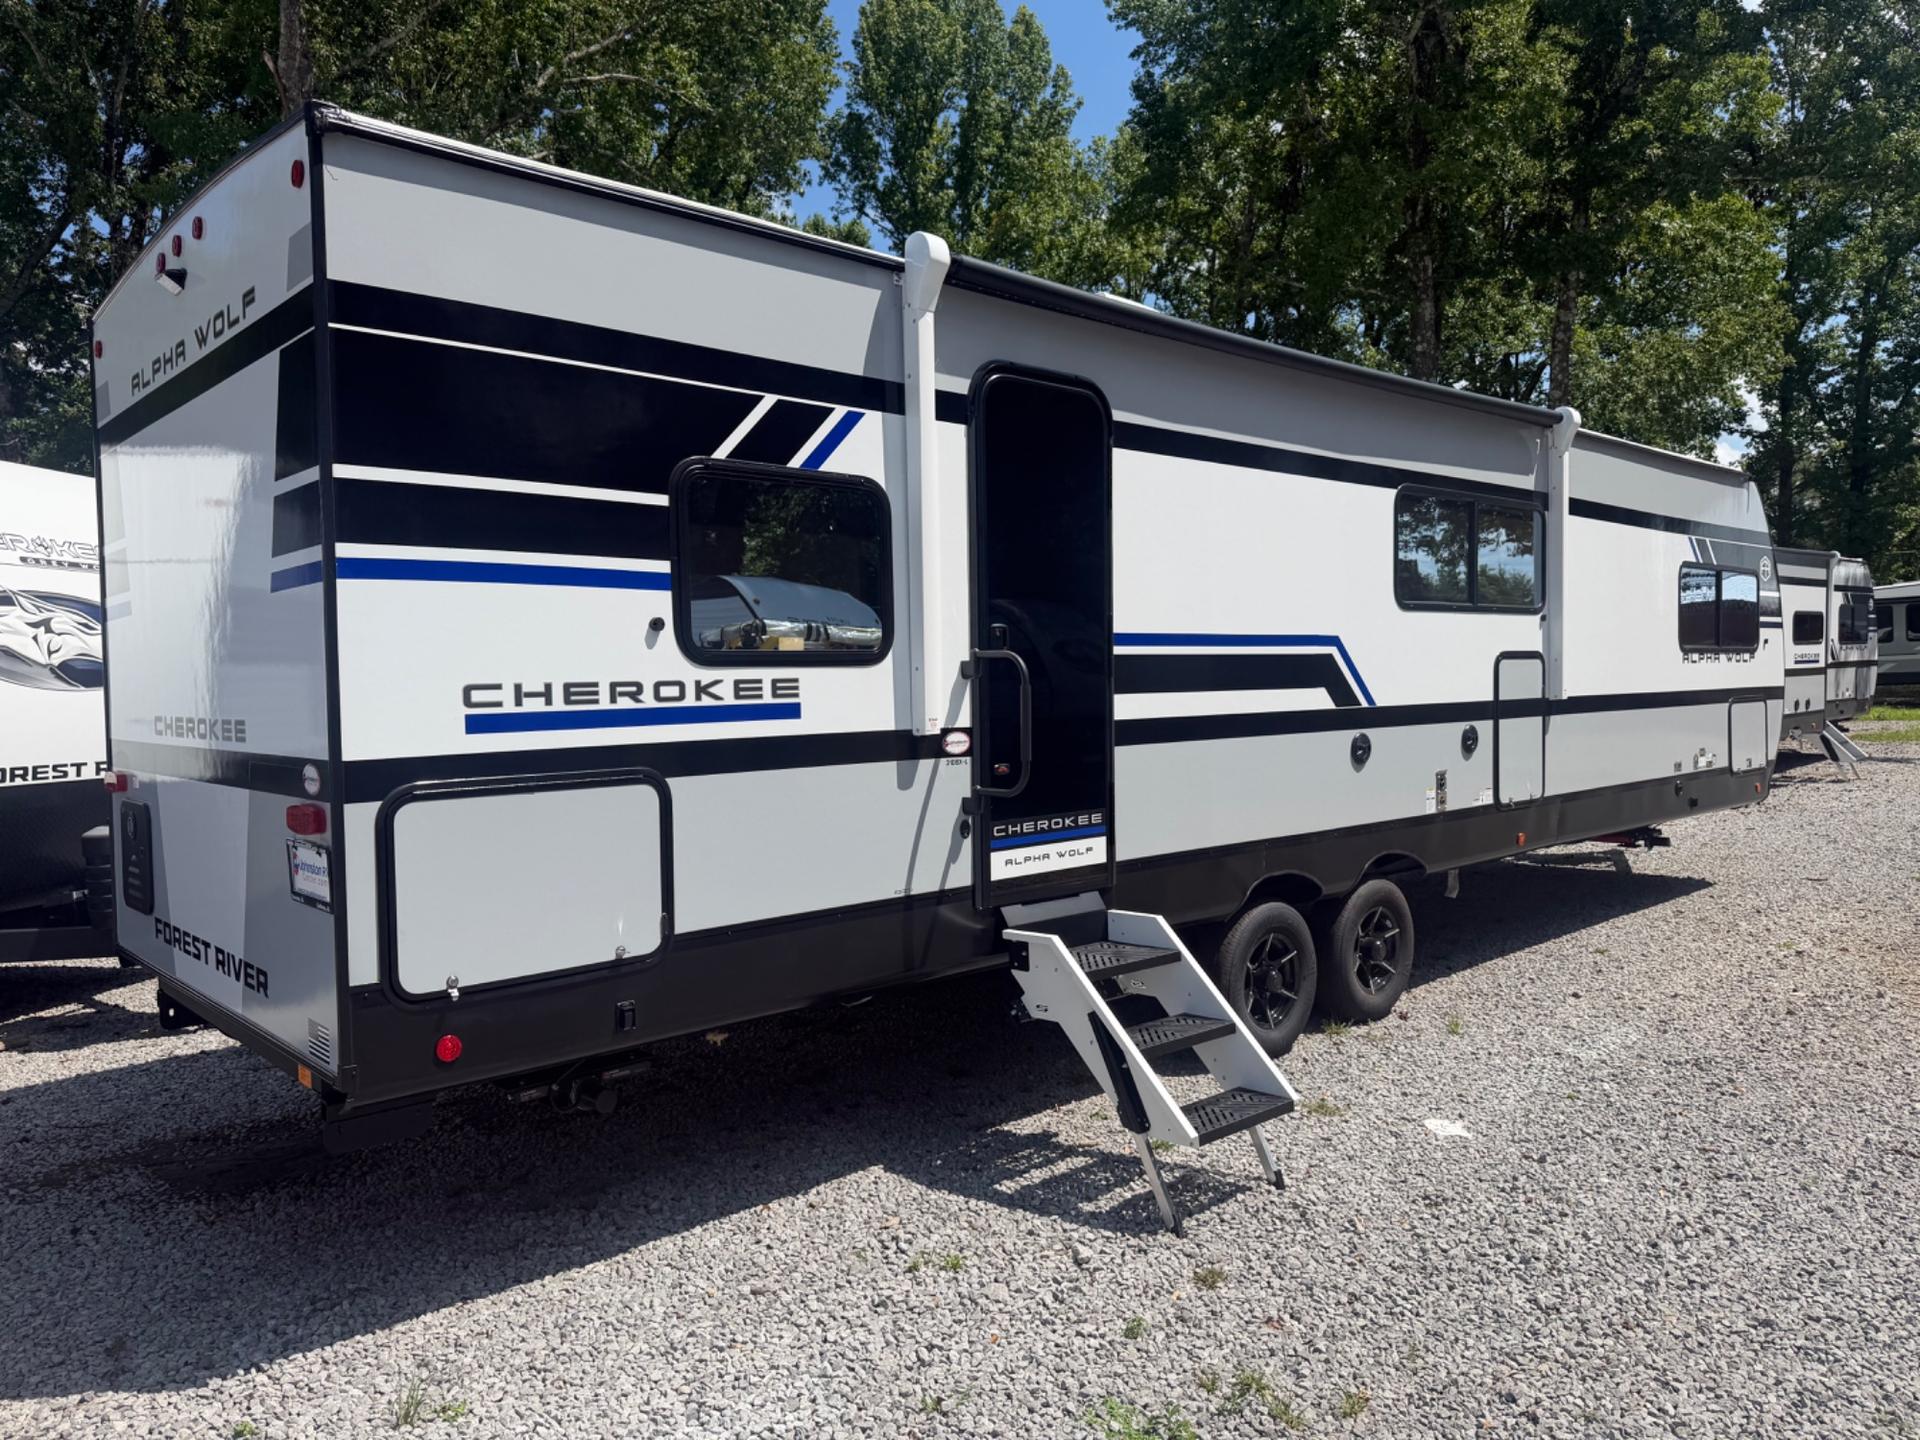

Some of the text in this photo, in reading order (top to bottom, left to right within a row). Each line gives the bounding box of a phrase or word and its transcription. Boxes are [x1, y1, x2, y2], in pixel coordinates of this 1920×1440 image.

[131, 285, 256, 396] ALPHA WOLF
[1682, 652, 1755, 664] ALPHA WOLF
[462, 678, 800, 709] CHEROKEE
[154, 715, 247, 743] CHEROKEE
[993, 813, 1103, 837] CHEROKEE
[1005, 846, 1094, 867] ALPHA WOLF
[154, 916, 270, 999] FOREST RIVER
